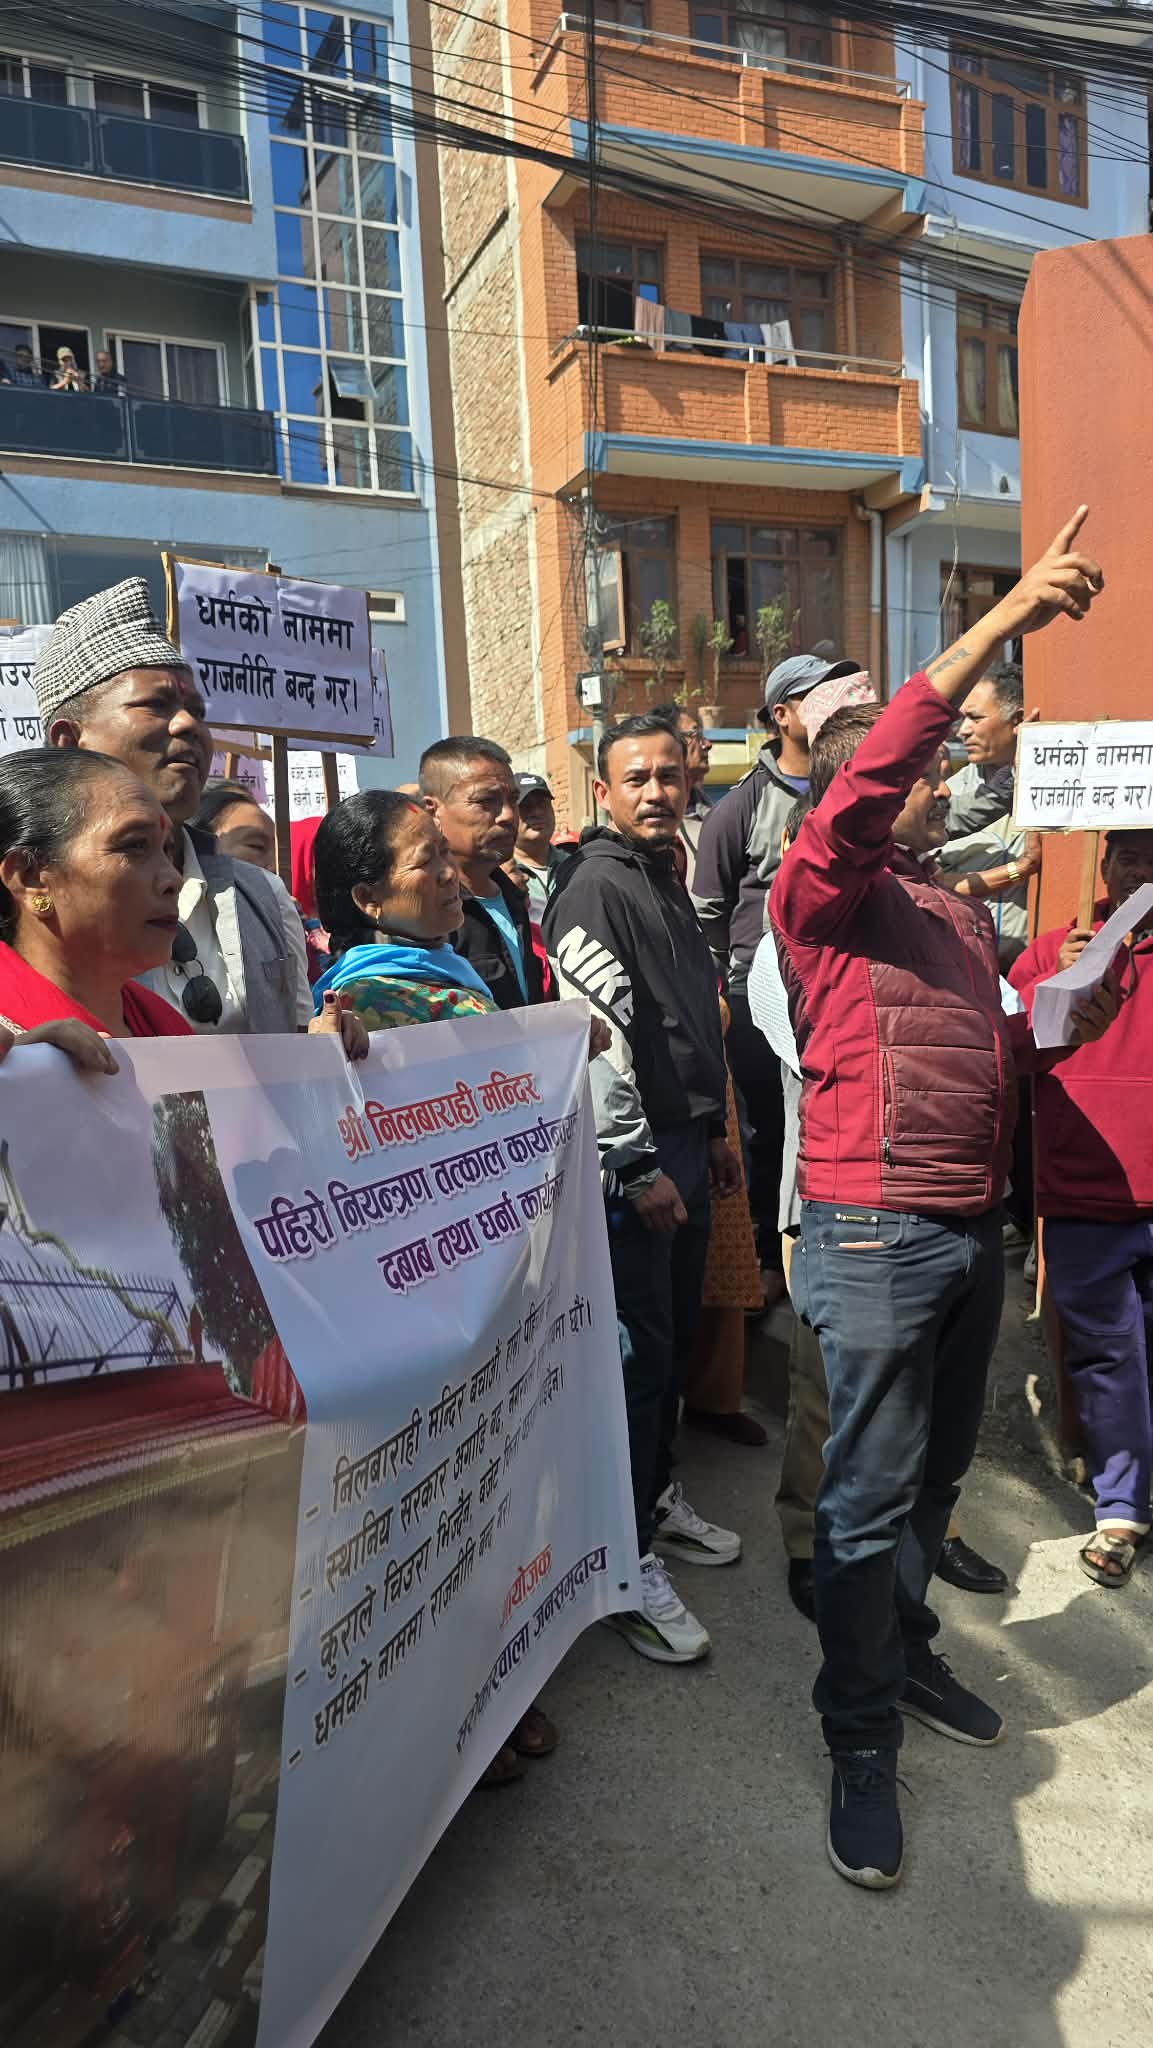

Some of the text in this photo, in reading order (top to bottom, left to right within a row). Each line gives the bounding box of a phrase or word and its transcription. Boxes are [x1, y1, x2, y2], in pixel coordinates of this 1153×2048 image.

[195, 590, 354, 650] धर्मको नाममा
[197, 653, 276, 698] राजनीति
[284, 670, 316, 709] बन्द
[324, 675, 358, 713] गर।
[1030, 778, 1087, 811] राजनीति
[1033, 739, 1153, 766] धर्मको नाममा
[337, 1071, 541, 1157] श्री निलबाराही मन्दिर
[254, 1190, 334, 1258] पहिरो
[327, 1168, 433, 1233] नियन्त्रण
[430, 1141, 507, 1195] तत्काल
[377, 1237, 436, 1291] दबाब
[431, 1217, 480, 1266] तथा
[333, 1408, 422, 1512] निलबाराही
[428, 1385, 466, 1438] मन्दिर
[326, 1505, 394, 1593] स्थानिय
[400, 1458, 450, 1533] सरकार
[320, 1584, 376, 1680] कुराले
[384, 1536, 432, 1613] चिउरा
[533, 1546, 608, 1637] जनसमुदाय
[314, 1658, 373, 1744] धर्मको
[377, 1605, 426, 1680] नाममा
[430, 1537, 477, 1626] राजनीति
